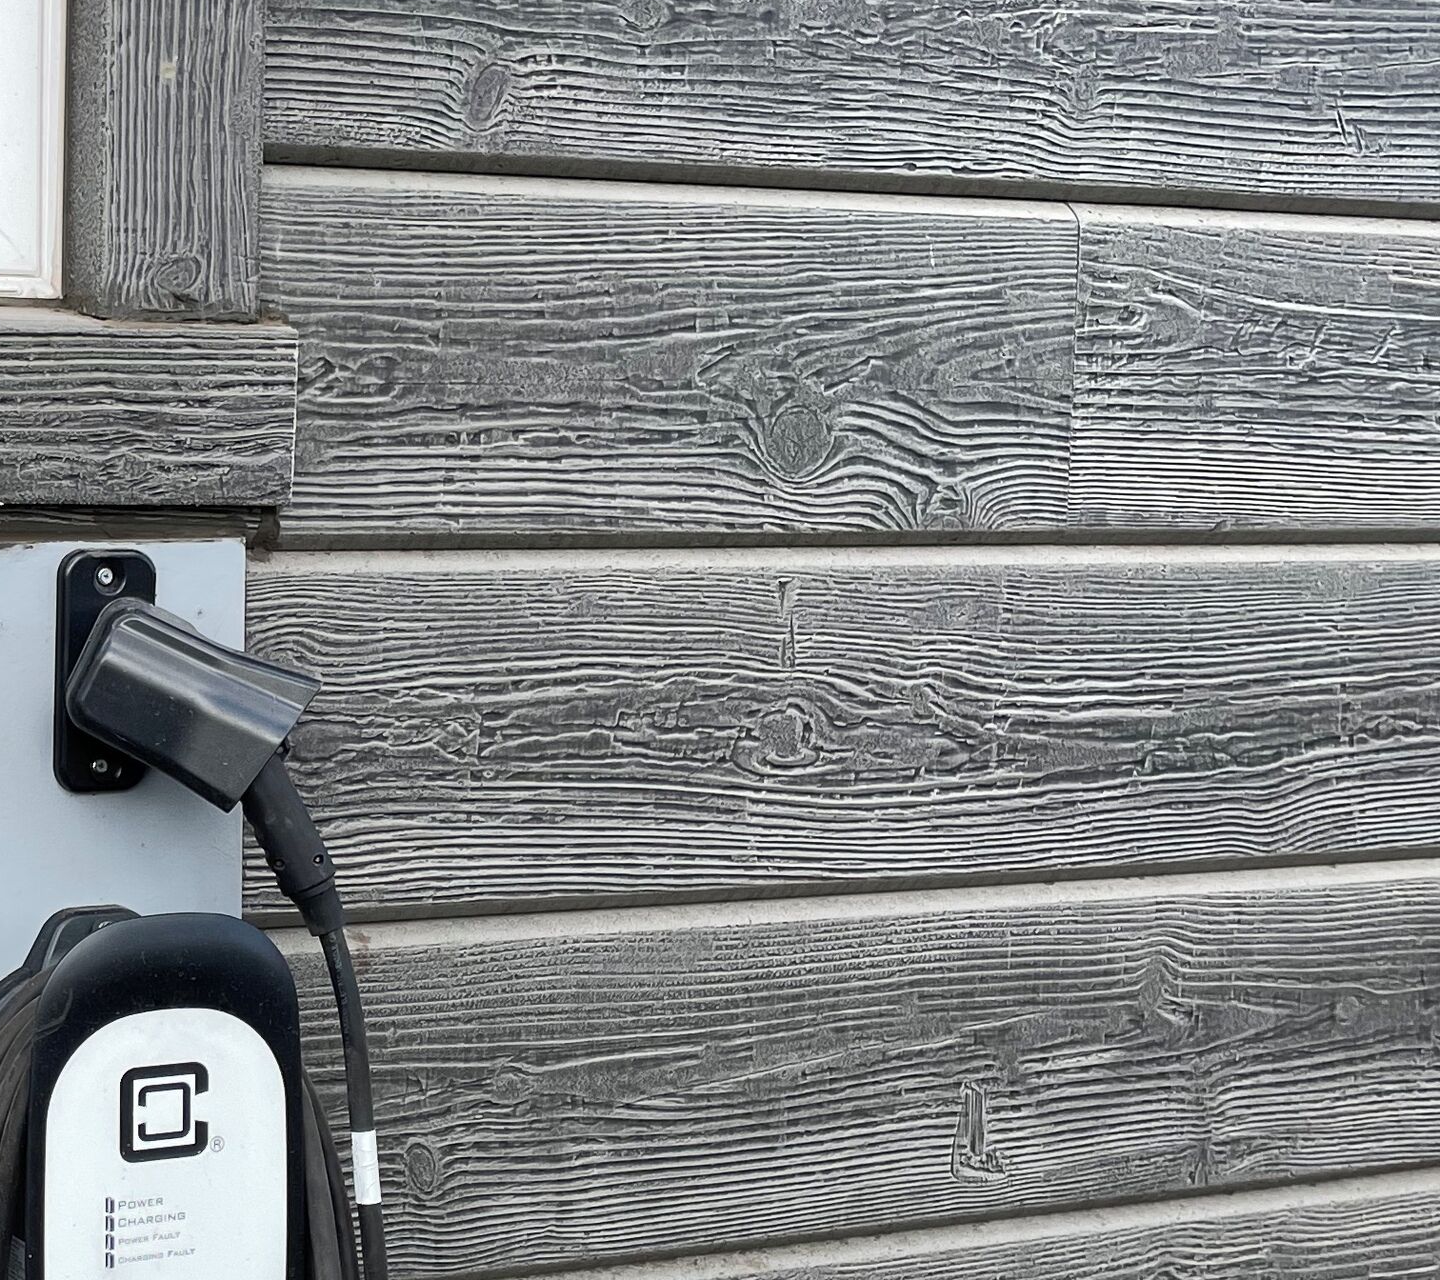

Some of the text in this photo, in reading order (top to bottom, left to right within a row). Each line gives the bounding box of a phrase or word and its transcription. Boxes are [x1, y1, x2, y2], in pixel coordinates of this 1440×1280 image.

[117, 1197, 164, 1210] POWER
[117, 1211, 186, 1228] CHARGING
[152, 1231, 181, 1241] FAULT
[167, 1247, 196, 1258] FAULT
